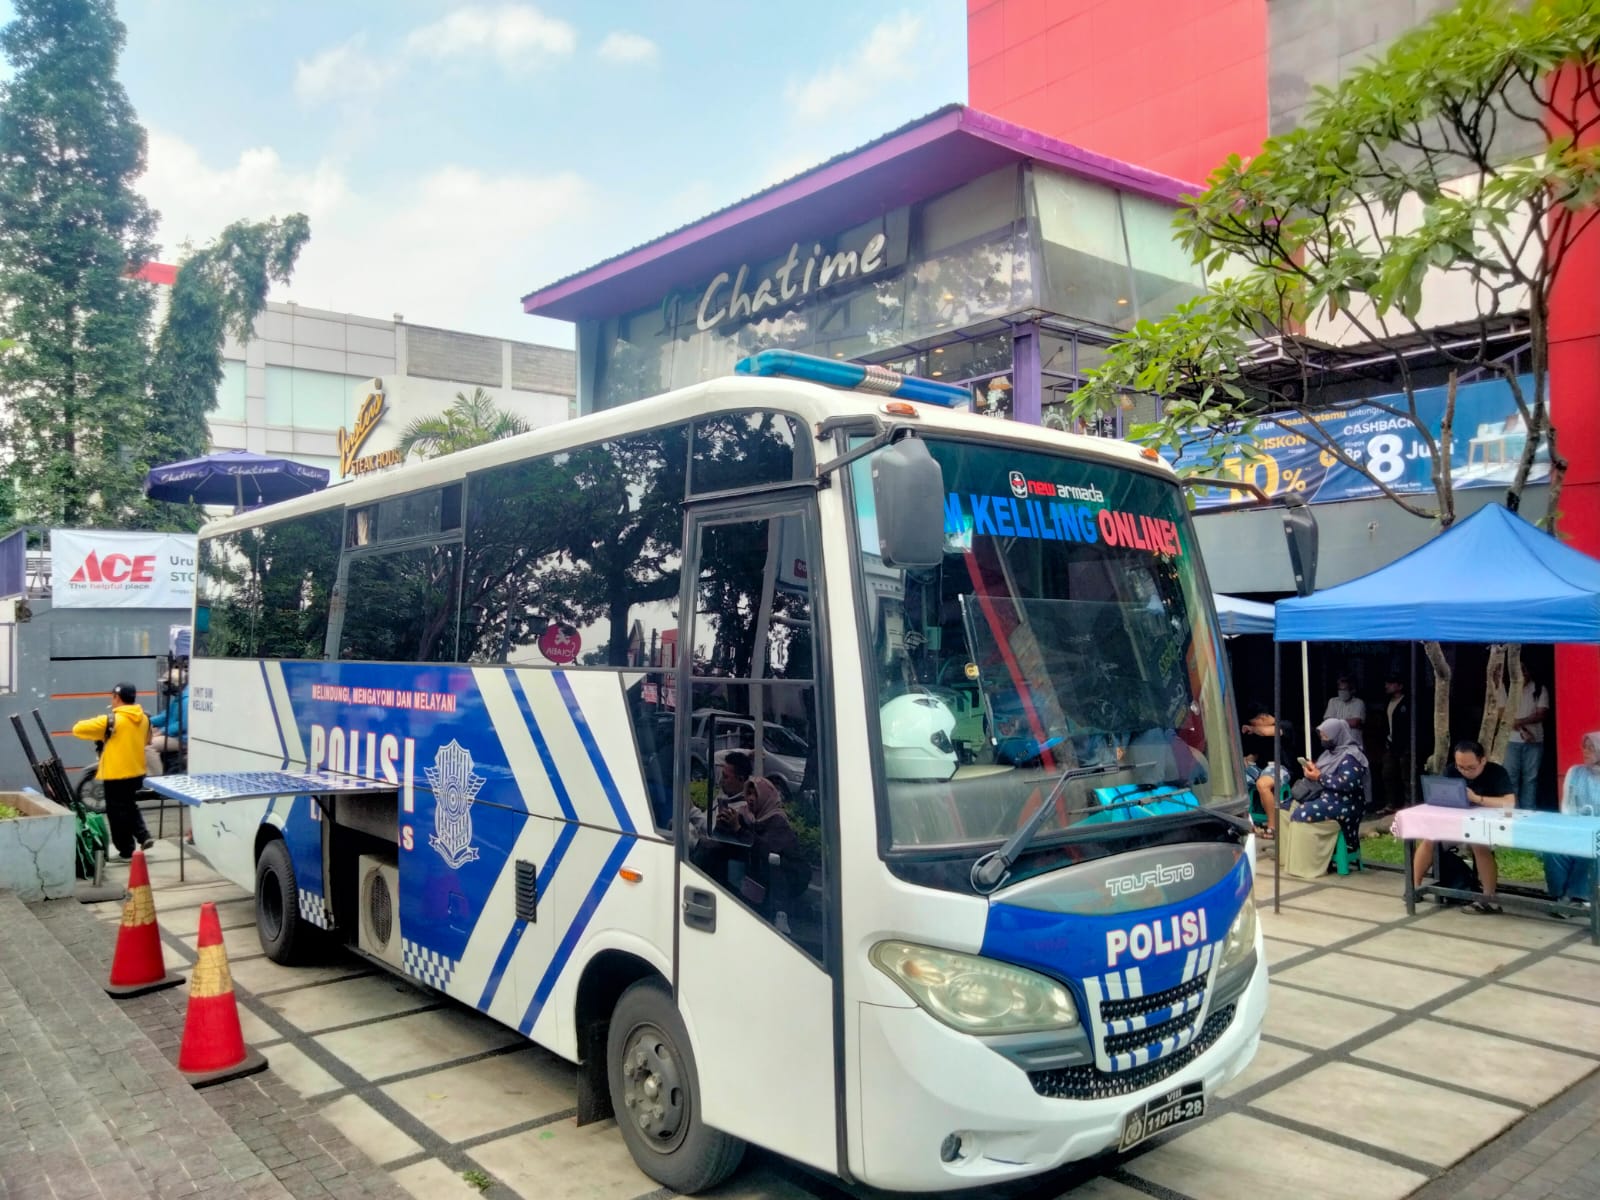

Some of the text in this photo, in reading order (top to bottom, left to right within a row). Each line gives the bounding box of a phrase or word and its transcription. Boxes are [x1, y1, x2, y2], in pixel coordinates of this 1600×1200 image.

[697, 233, 886, 330] Chatime
[1253, 434, 1307, 450] ISKON
[351, 456, 377, 475] STEAK
[1366, 433, 1405, 482] 8
[1027, 480, 1104, 503] new armada
[970, 495, 1099, 544] KELILING
[69, 548, 157, 583] ACE
[90, 583, 123, 591] helpful
[352, 687, 395, 708] MENGAYOMI
[396, 691, 412, 708] DAN
[413, 692, 457, 713] MELAYANI
[1106, 907, 1207, 968] POLISI
[1166, 1087, 1182, 1102] VIII
[1148, 1099, 1203, 1131] 11015-28
